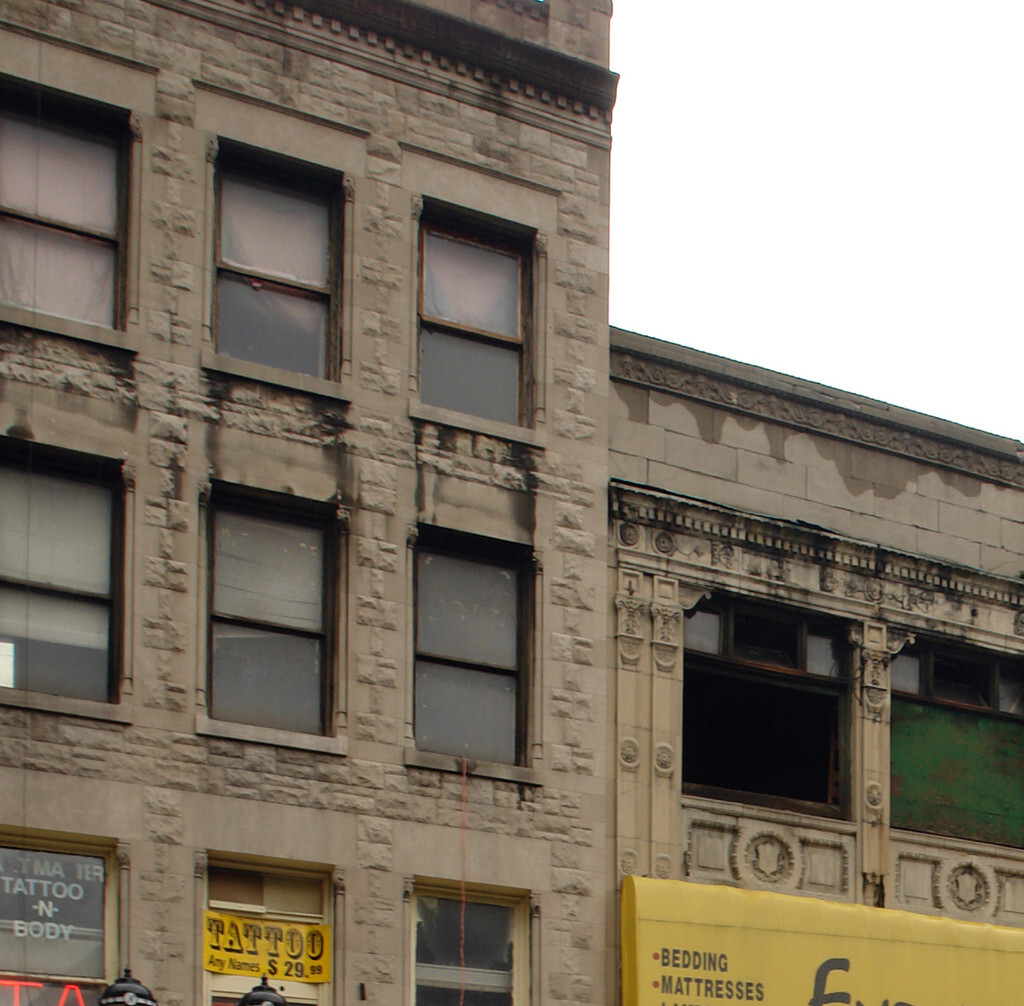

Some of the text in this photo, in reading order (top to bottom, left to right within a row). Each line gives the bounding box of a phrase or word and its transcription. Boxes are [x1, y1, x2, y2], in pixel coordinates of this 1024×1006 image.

[1, 876, 84, 900] TATTOO
[14, 920, 75, 940] BODY
[207, 917, 324, 960] TATTOO
[208, 954, 226, 971] Any
[229, 957, 261, 973] Names
[661, 948, 728, 972] BEDDING
[661, 975, 764, 1002] MATTRESSES
